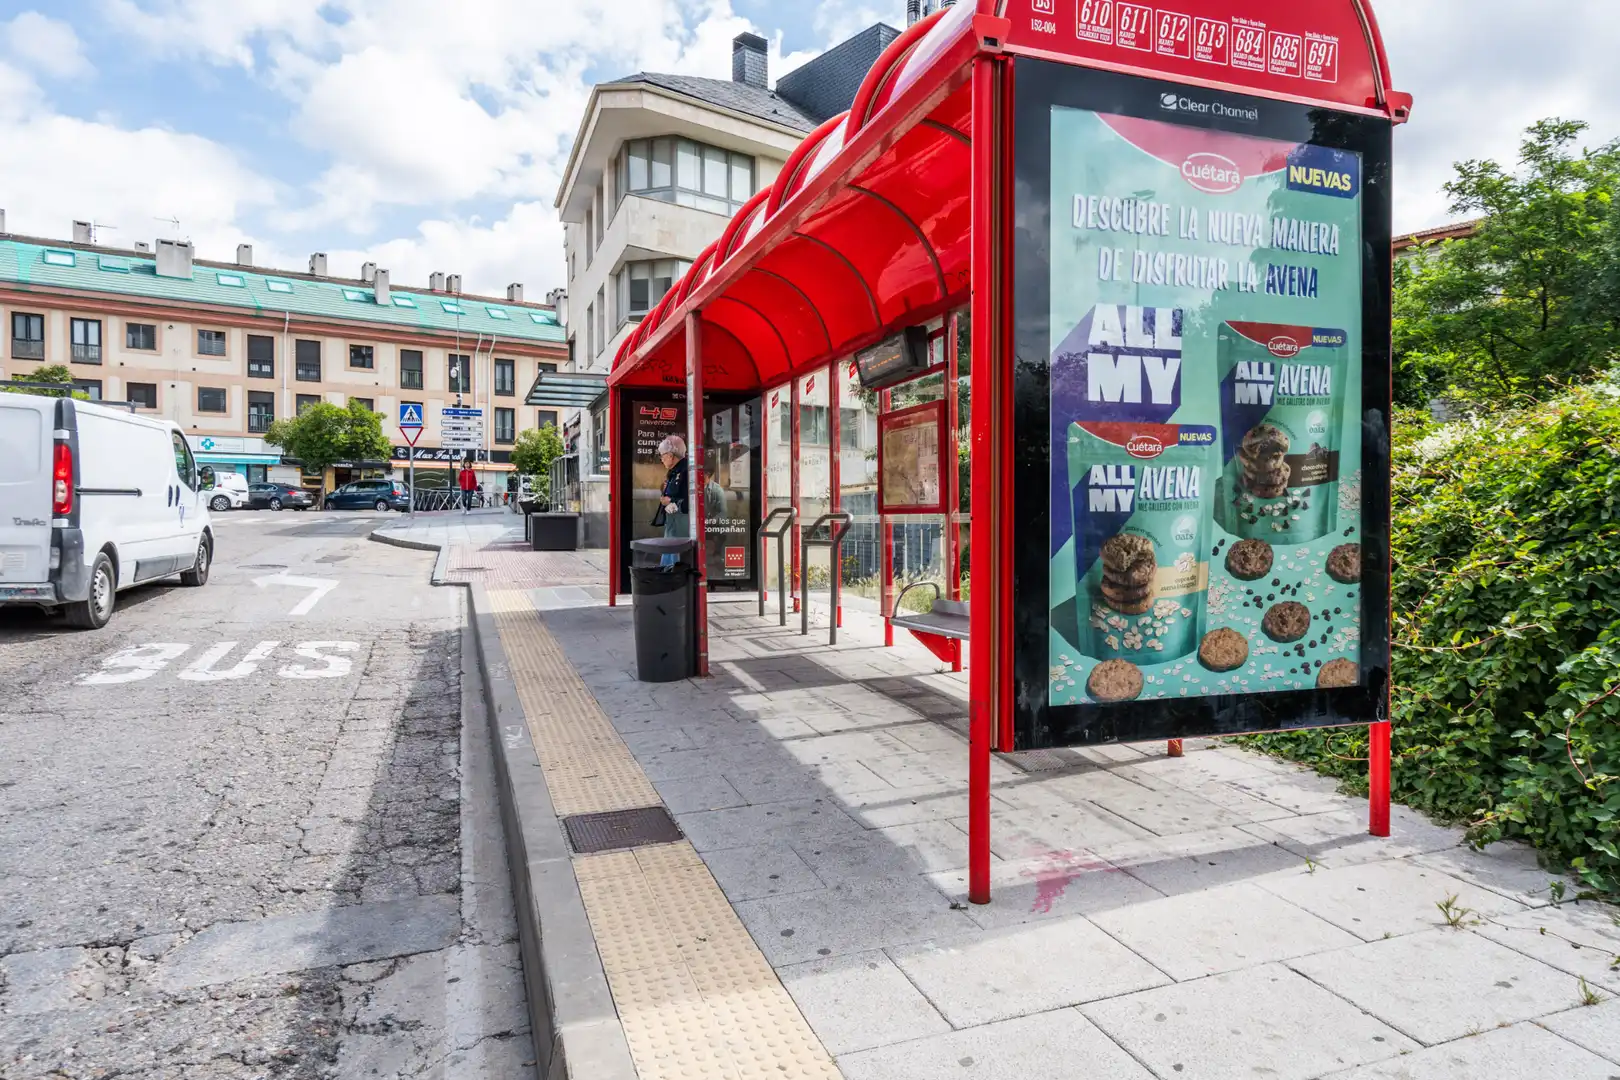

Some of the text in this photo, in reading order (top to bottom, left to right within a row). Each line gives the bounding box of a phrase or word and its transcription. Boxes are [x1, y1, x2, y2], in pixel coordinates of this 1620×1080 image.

[1081, 0, 1110, 26] 610
[1120, 7, 1149, 34] 611
[1031, 19, 1056, 35] 152-004
[1160, 14, 1188, 42] 612
[1198, 22, 1226, 49] 613
[1235, 29, 1263, 55] 684
[1272, 35, 1299, 61] 685
[1308, 41, 1335, 67] 691
[1178, 97, 1259, 120] Clear Channel
[1181, 160, 1241, 186] Cuétara
[1289, 164, 1352, 192] NUEVAS
[1072, 193, 1340, 256] DESCUBRE LA NUEVA MANERA
[1098, 246, 1318, 299] DE DISFRUTAR LA AVENA
[1088, 303, 1182, 350] ALL
[1312, 335, 1342, 344] NUEVAS
[1268, 341, 1299, 353] Cuétara
[1087, 353, 1181, 404] MY
[1234, 360, 1275, 382] ALL
[1278, 363, 1332, 397] AVENA
[1234, 382, 1275, 406] MY
[637, 430, 655, 438] Para
[1126, 441, 1163, 453] Cuétara
[1179, 432, 1212, 442] NUEVAS
[1088, 464, 1136, 486] ALL
[1138, 465, 1200, 501] AVENA
[1088, 488, 1135, 513] MY
[1148, 502, 1171, 512] GALLETAS
[74, 640, 360, 685] BUS
